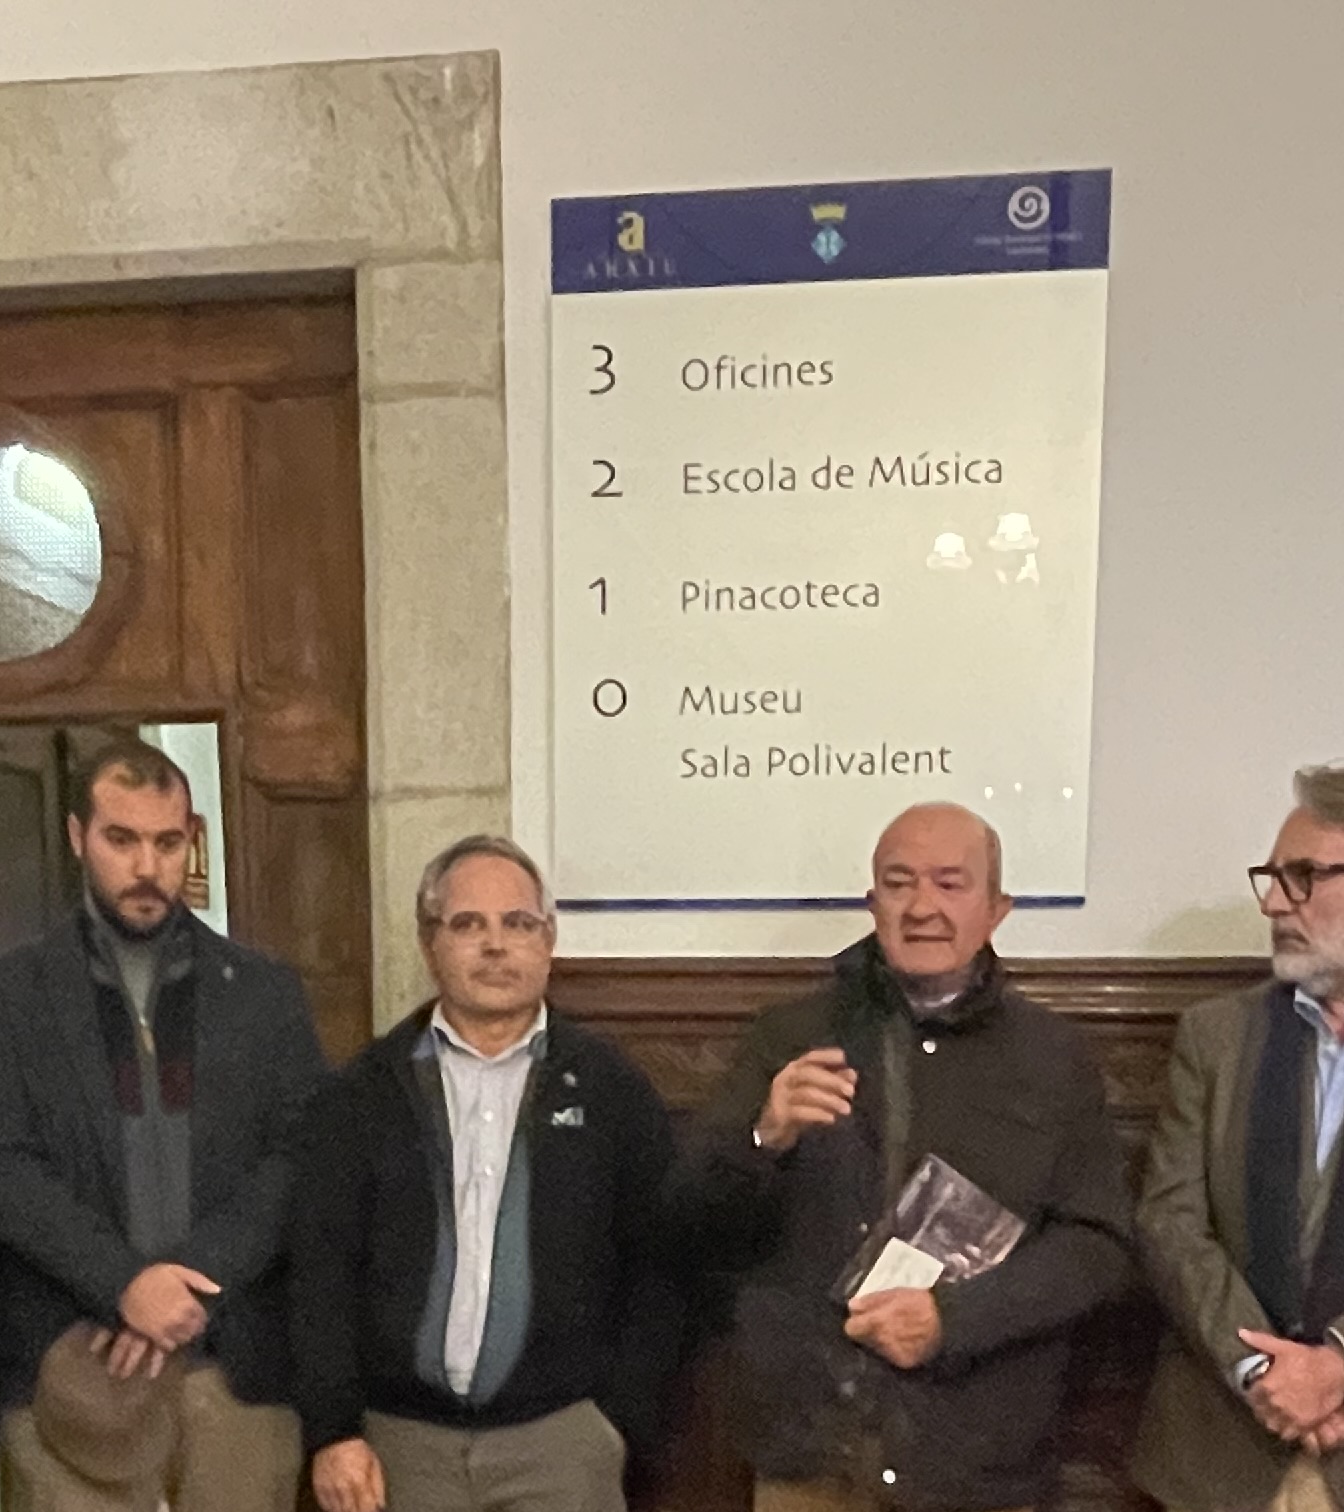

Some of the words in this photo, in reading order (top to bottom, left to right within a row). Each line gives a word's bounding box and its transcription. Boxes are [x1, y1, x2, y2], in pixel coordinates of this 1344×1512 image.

[588, 344, 617, 396] 3
[681, 353, 834, 392] Oficines
[590, 459, 624, 498] 2
[682, 457, 796, 495] Escola
[810, 454, 855, 491] de
[868, 450, 1003, 489] Música
[588, 576, 608, 616] 1
[681, 579, 880, 614] Pinacoteca
[678, 684, 802, 716] Museu
[680, 744, 751, 779] Sala
[767, 741, 953, 778] Polivalent
